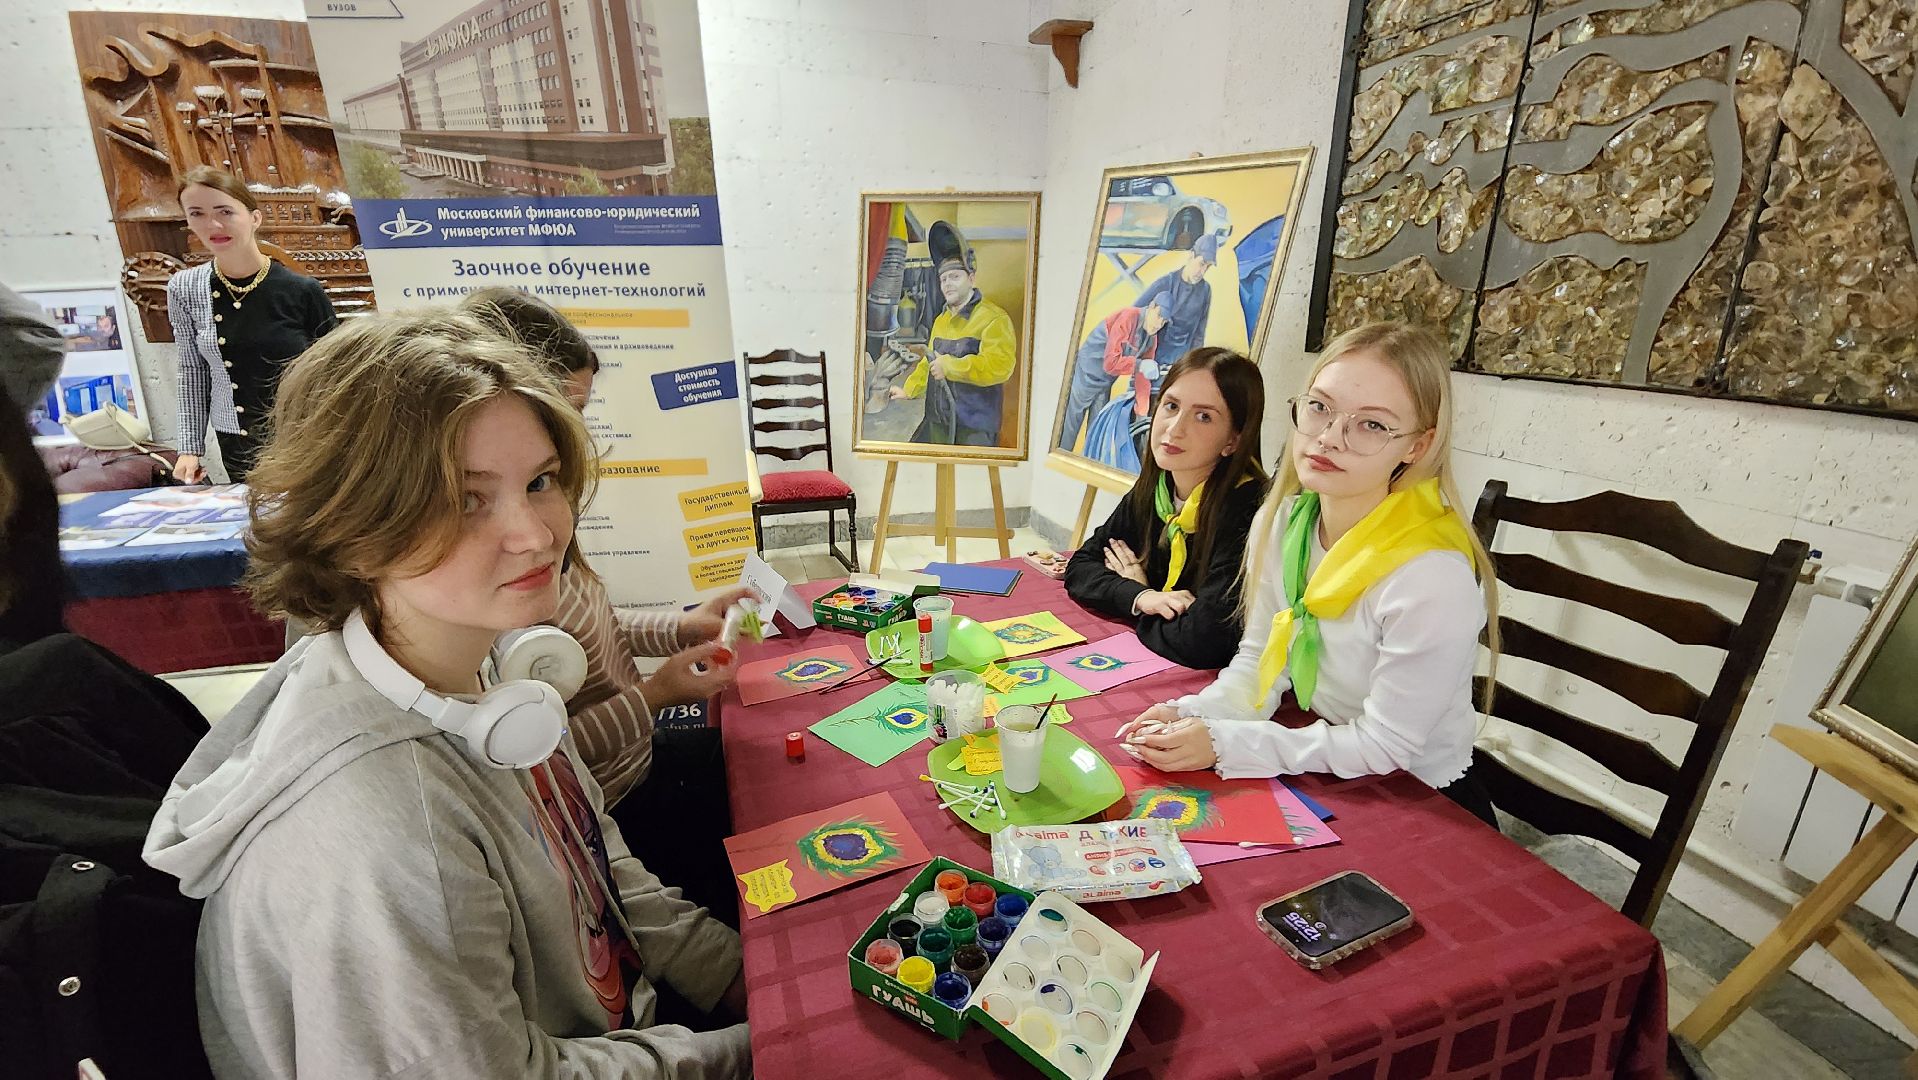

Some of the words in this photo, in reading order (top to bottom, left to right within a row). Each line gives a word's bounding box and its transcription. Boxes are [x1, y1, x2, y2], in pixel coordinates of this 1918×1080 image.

[327, 3, 357, 12] ВУЗОВ
[438, 15, 482, 55] МФЮА
[437, 205, 522, 220] Московский
[525, 204, 700, 221] финансово-юридический
[440, 225, 525, 240] университет
[528, 223, 576, 237] МФЮА
[452, 259, 542, 276] Заочное
[548, 256, 650, 280] обучение
[403, 287, 412, 297] с
[534, 283, 706, 299] интернет-технологий
[674, 367, 718, 384] Доступная
[678, 379, 721, 393] стоимость
[682, 389, 723, 403] обучения
[600, 465, 660, 477] разование
[684, 486, 749, 505] Государственный
[704, 500, 734, 512] диплом
[715, 526, 753, 537] переводом
[706, 538, 730, 549] других
[730, 534, 750, 543] вузов
[1285, 911, 1322, 941] 12:25
[871, 983, 935, 1025] ГУАШЬ
